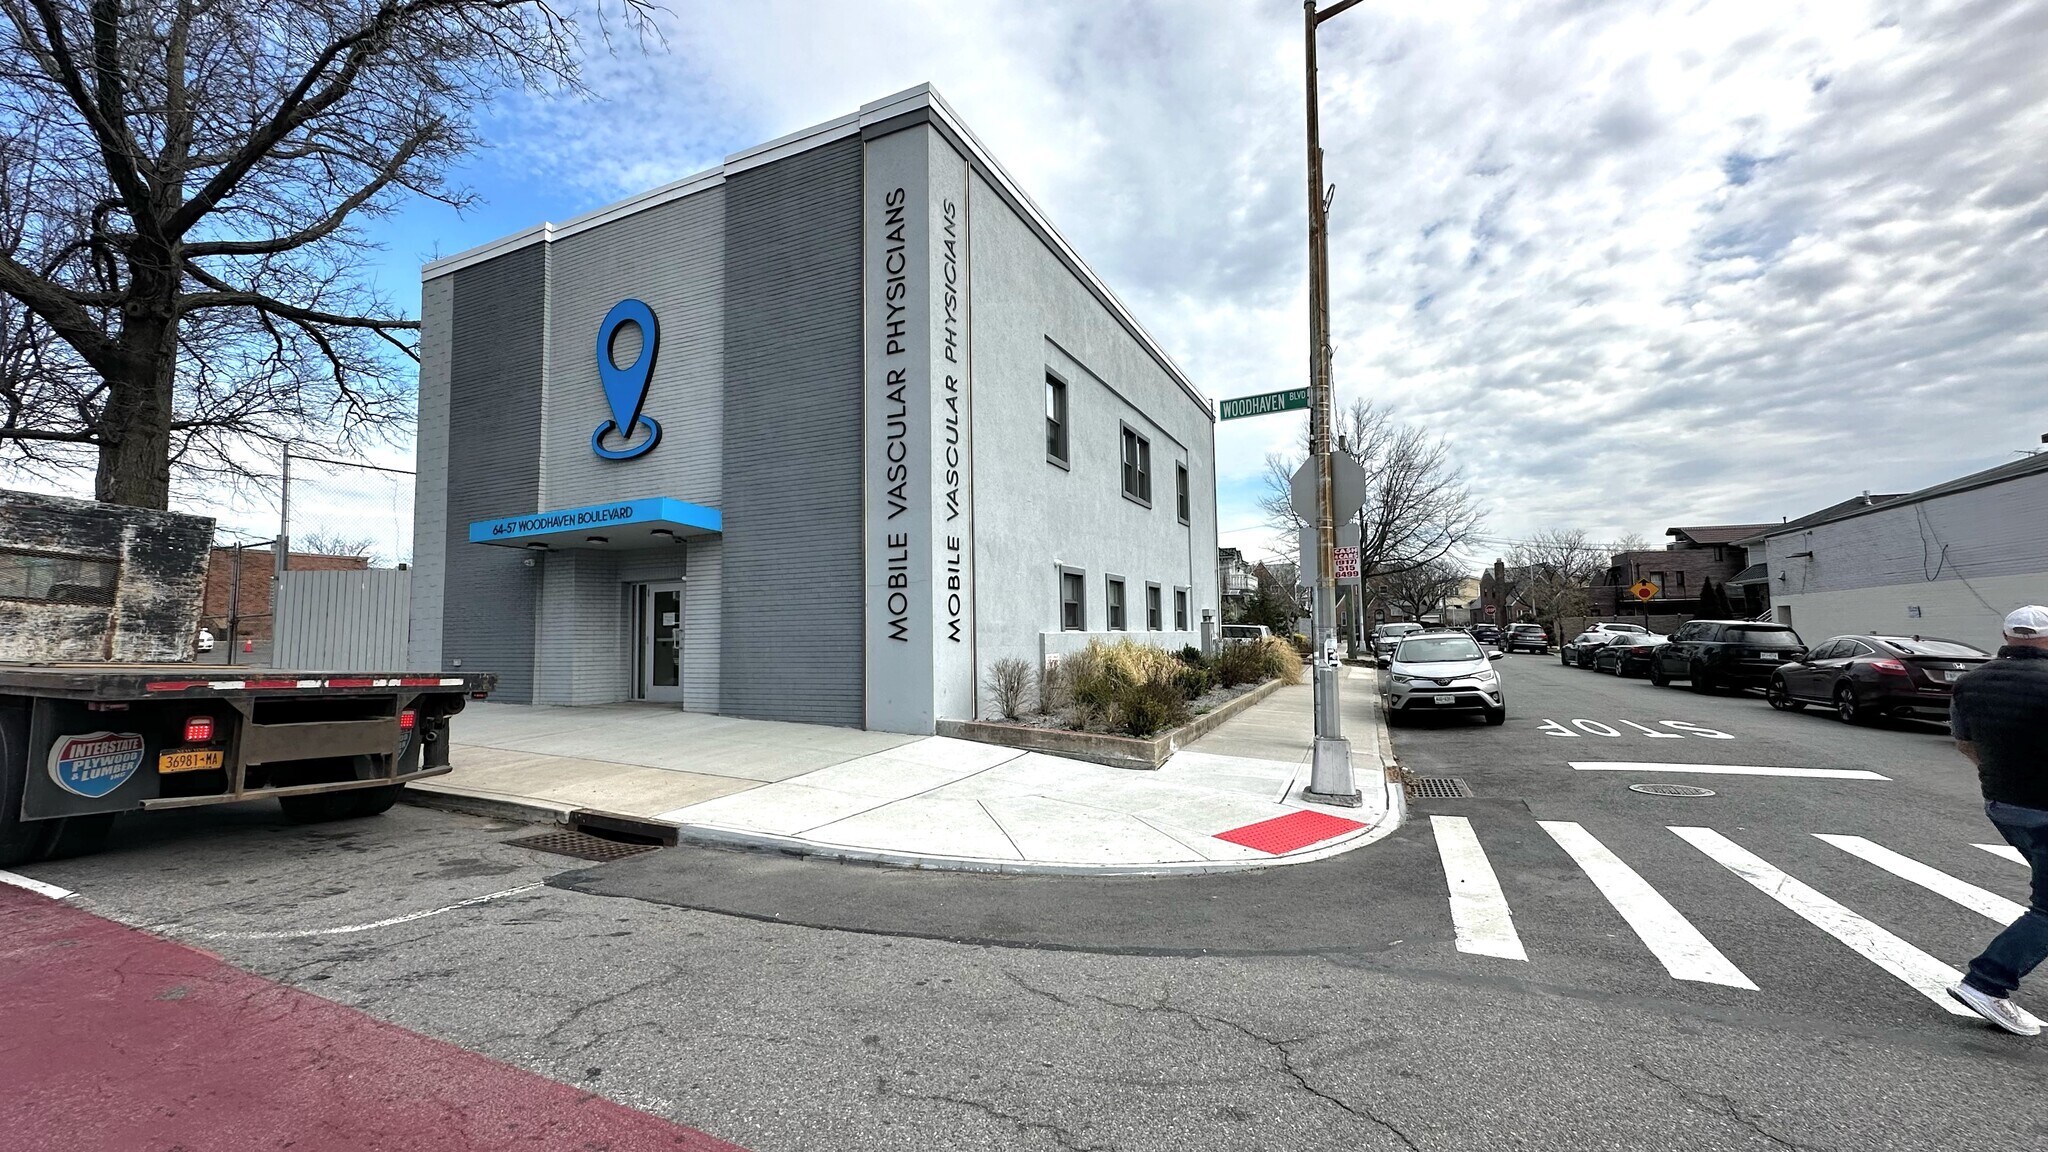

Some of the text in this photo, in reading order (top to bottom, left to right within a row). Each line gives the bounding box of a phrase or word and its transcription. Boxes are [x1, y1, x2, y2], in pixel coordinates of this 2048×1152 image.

[885, 187, 908, 642] MOBILE VASCULAR PHYSICIANS
[1222, 390, 1306, 418] WOODHAVEN BLVD
[943, 198, 961, 643] MOBILE VASCULAR PHYSICIANS
[492, 506, 633, 536] 64-57 WOODHAVEN BOULEVARD
[1536, 718, 1736, 740] STOP
[69, 738, 140, 759] INTERSTATE
[71, 751, 138, 772] PLYWOOD
[71, 762, 136, 782] & LUMBER
